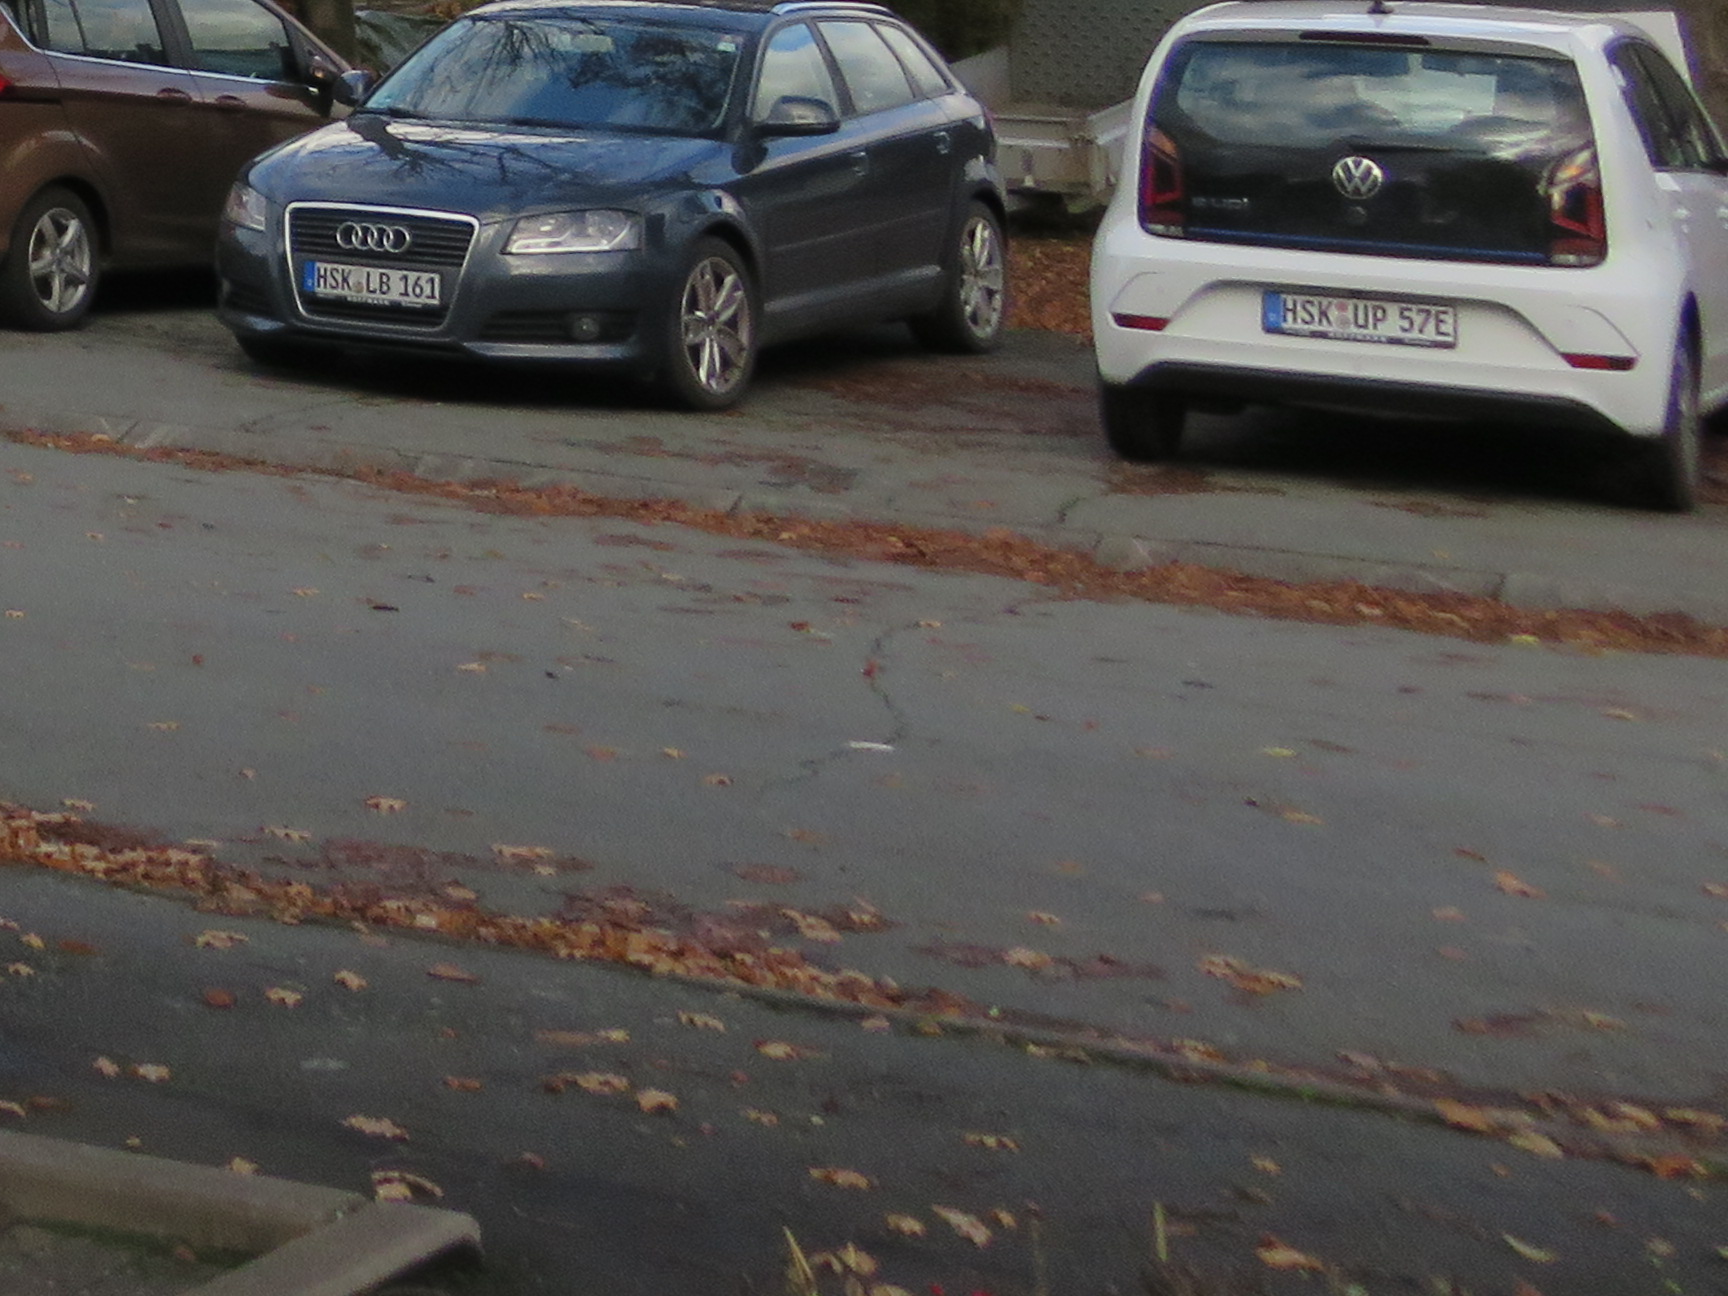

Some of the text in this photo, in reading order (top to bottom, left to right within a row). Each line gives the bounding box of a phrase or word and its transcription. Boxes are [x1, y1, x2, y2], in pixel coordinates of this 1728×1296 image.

[316, 266, 437, 300] HSK LB 161
[1282, 296, 1334, 328] HSK
[1353, 302, 1388, 331] UP
[1398, 306, 1452, 337] 57E
